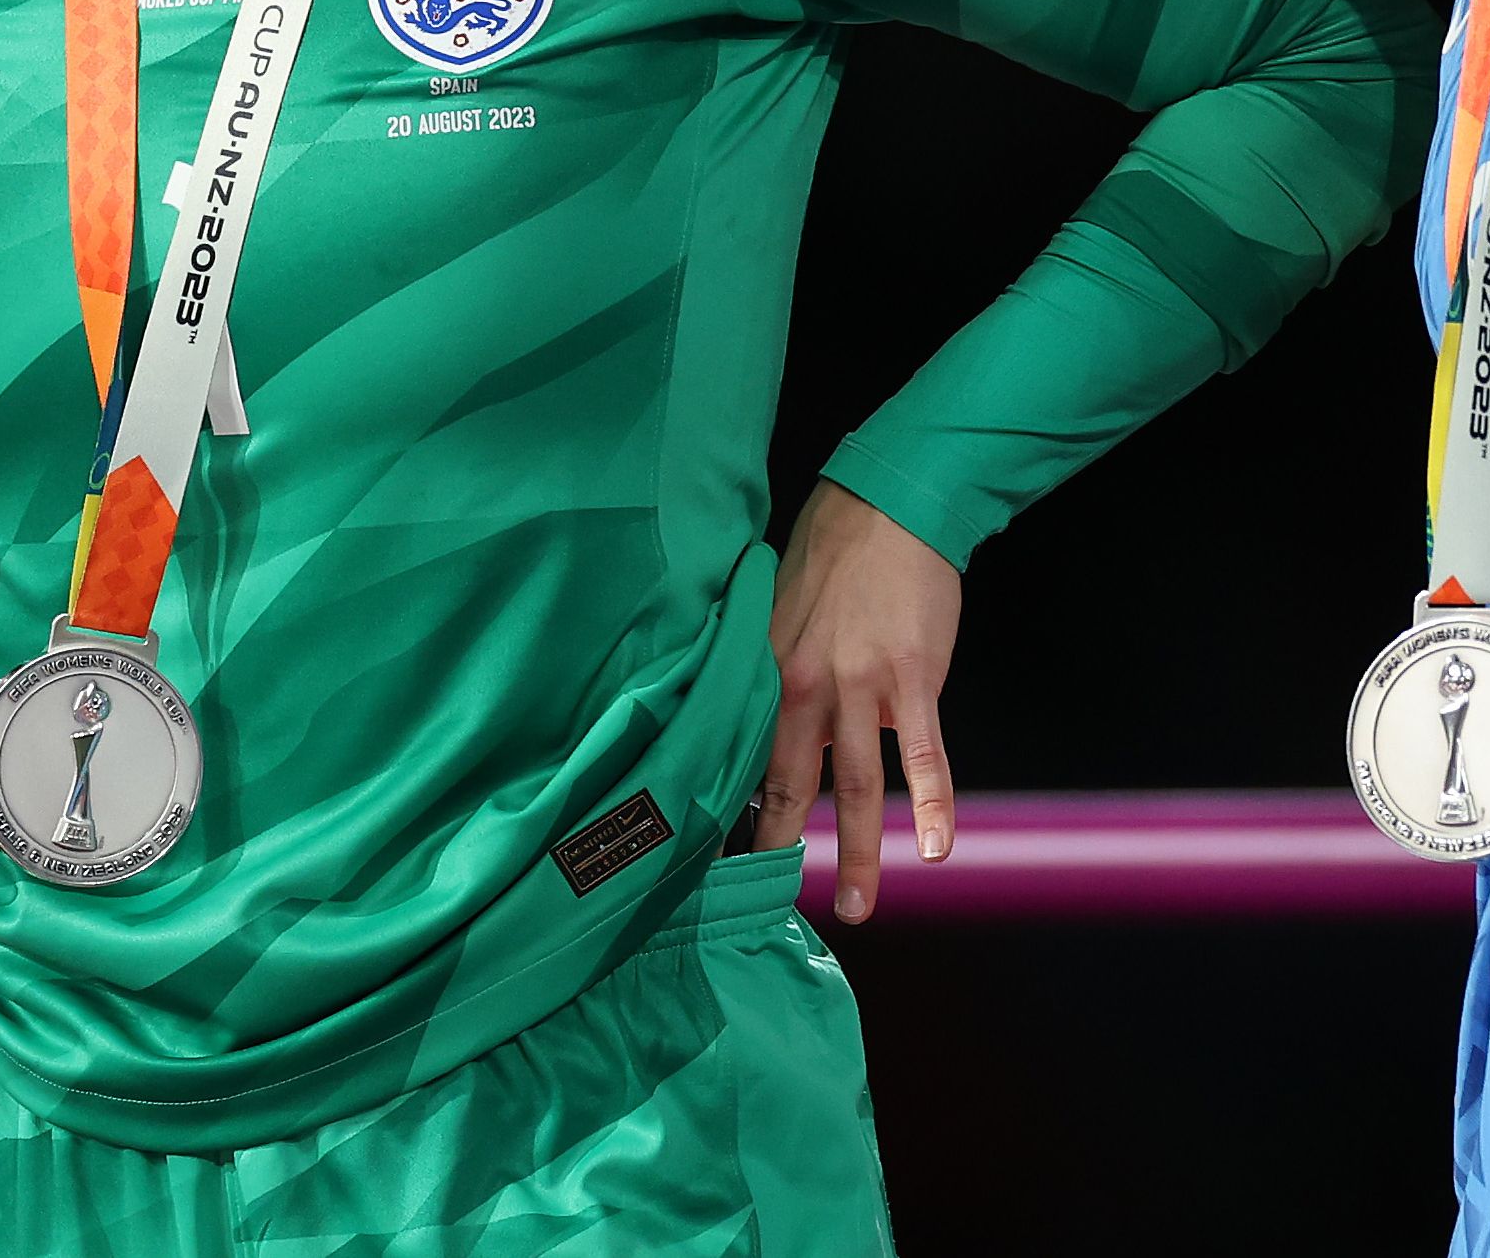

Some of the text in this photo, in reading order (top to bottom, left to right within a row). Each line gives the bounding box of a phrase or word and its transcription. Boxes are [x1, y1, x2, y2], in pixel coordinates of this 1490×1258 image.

[250, 4, 284, 77] CUP
[429, 76, 479, 96] SPAIN
[387, 105, 536, 138] 20 AUGUST 2023
[8, 653, 186, 727] FIFA WOMEN'S WORLD CUP
[43, 855, 80, 877] NEW
[81, 842, 155, 878] ZEALAND
